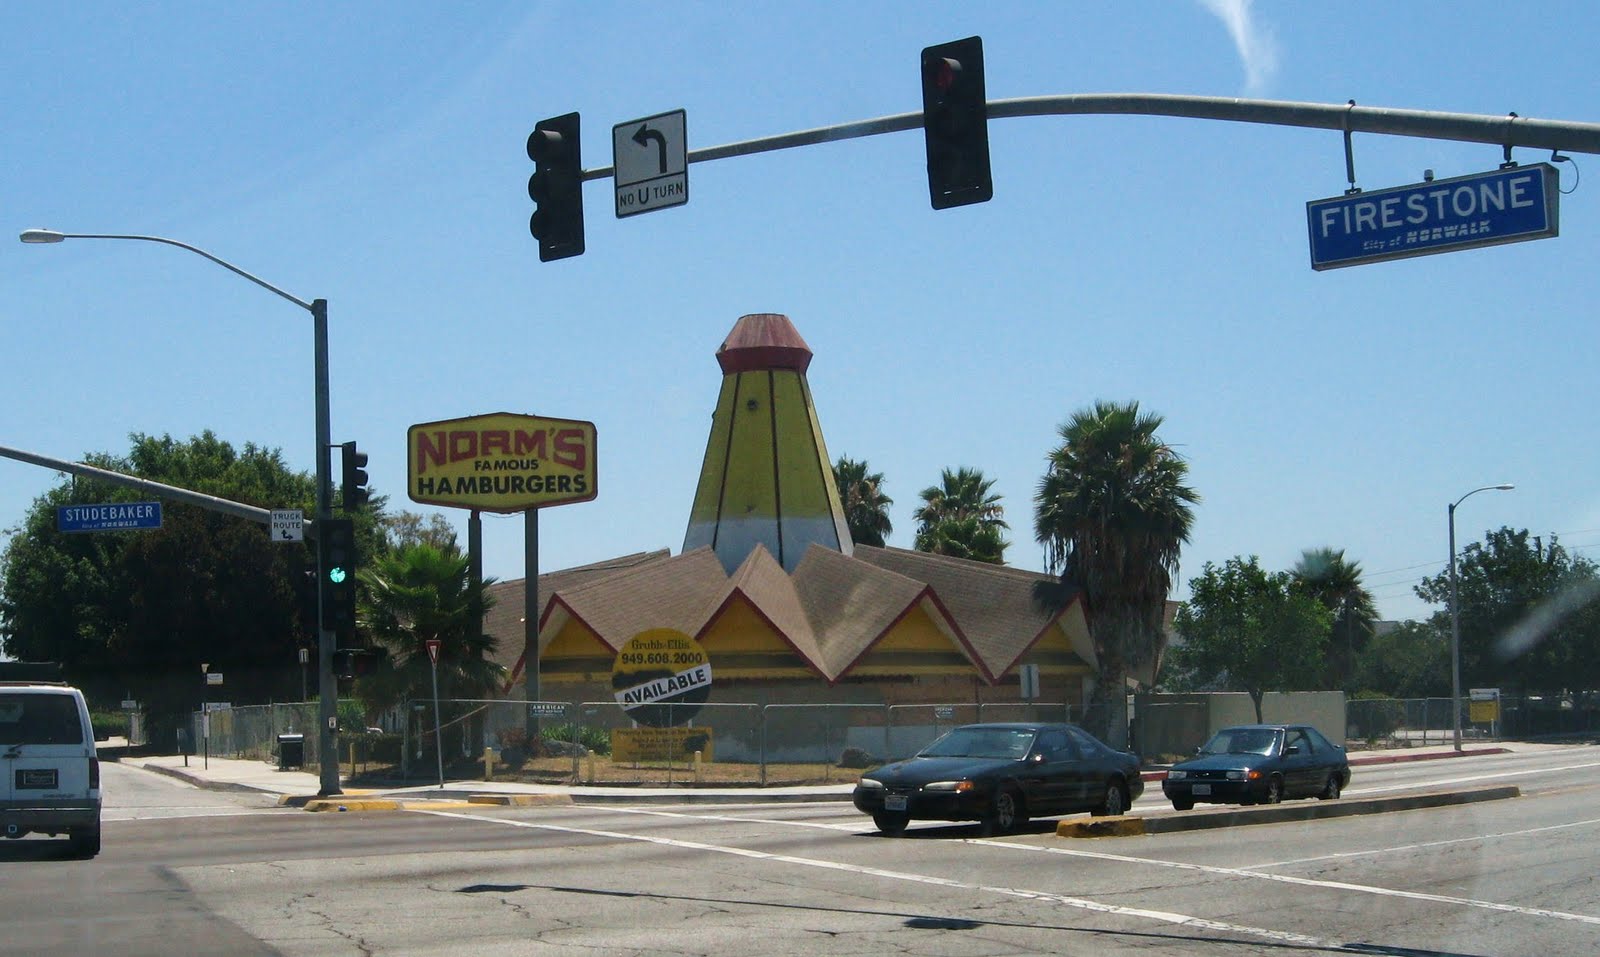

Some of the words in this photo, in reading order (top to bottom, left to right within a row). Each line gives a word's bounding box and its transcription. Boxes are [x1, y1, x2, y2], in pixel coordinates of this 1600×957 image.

[620, 193, 634, 207] NO
[638, 187, 649, 204] U
[653, 182, 683, 198] TURN
[1321, 176, 1533, 237] FIRESTONE
[1363, 239, 1384, 250] City
[1388, 235, 1401, 246] of
[1406, 220, 1491, 243] NORWALK
[417, 428, 586, 475] NORM'S
[474, 459, 539, 471] FAMOUS
[417, 474, 588, 495] HAMBURGERS
[66, 505, 153, 521] STUDEBAKER
[621, 653, 702, 665] 949.608.2000
[623, 669, 707, 706] AVAILABLE
